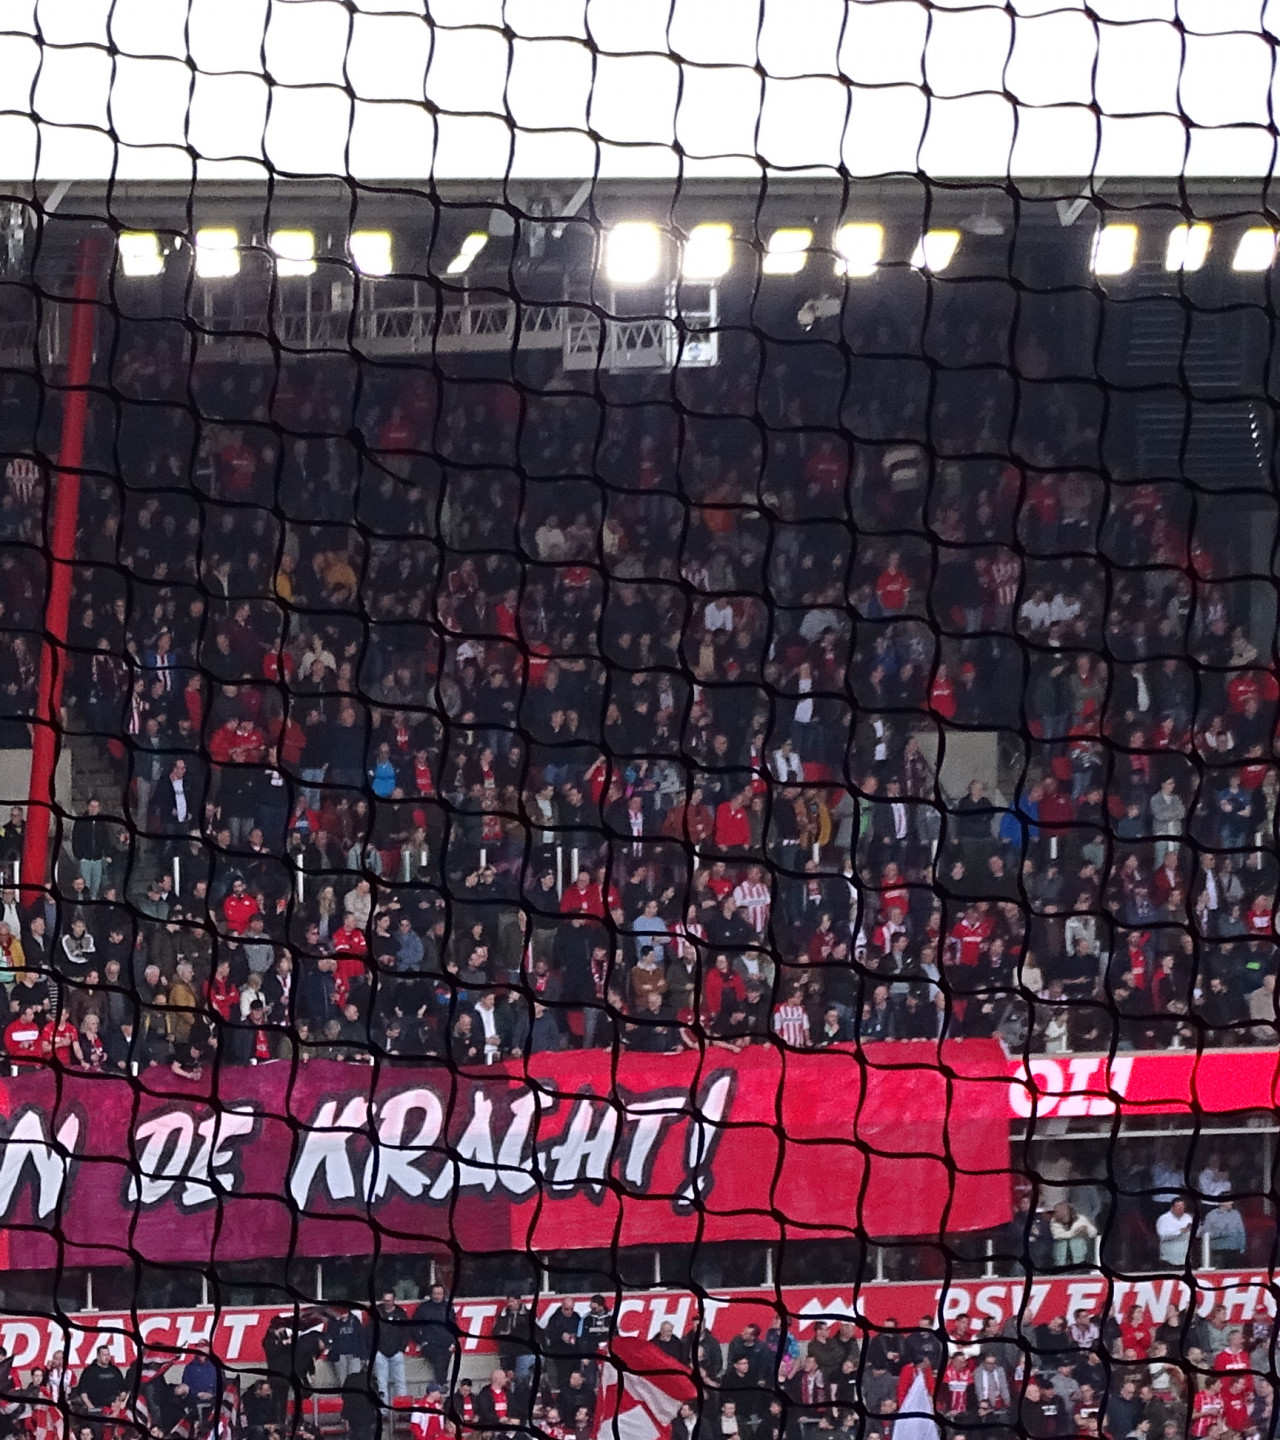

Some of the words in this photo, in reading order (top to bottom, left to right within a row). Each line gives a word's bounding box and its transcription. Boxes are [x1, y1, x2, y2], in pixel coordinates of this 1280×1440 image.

[129, 1106, 254, 1204] DE
[290, 1071, 731, 1210] KRACHT!
[934, 1283, 1051, 1329] PSV
